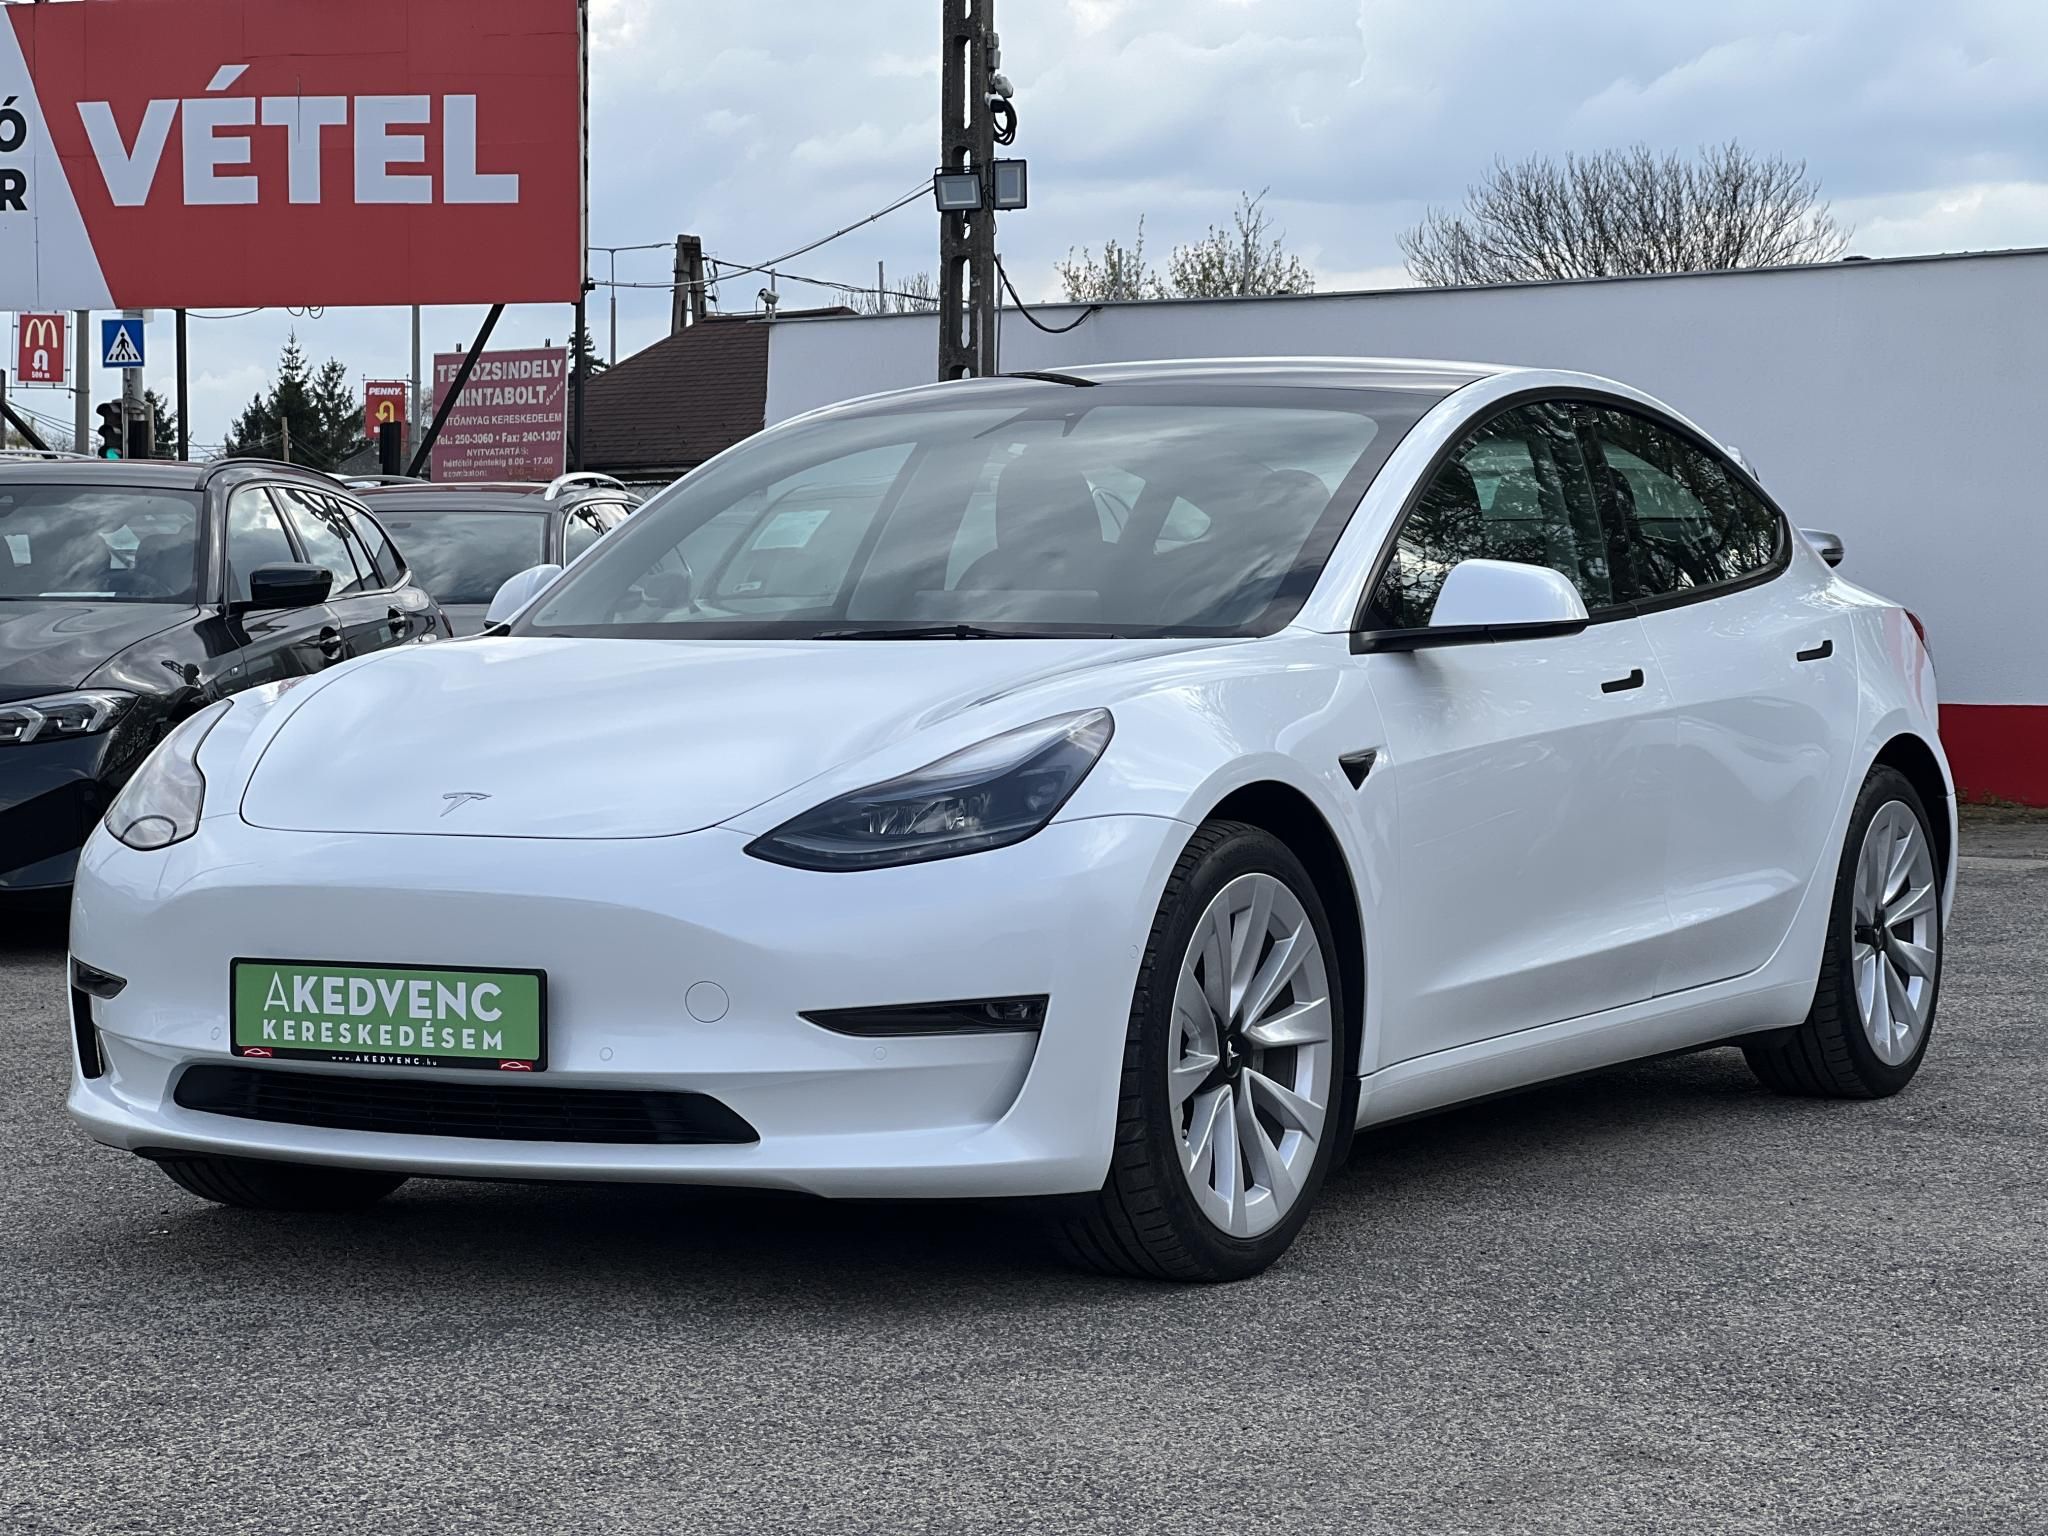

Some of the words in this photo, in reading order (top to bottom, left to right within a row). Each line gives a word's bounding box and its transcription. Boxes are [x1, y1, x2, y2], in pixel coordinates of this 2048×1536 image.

[76, 64, 520, 207] VÉTEL
[437, 358, 563, 383] TEŐZSINDELY
[492, 413, 562, 425] KERESKEDELEM
[455, 432, 494, 444] 250-3060
[502, 432, 520, 443] Fax:
[522, 431, 562, 442] 240-1307
[466, 447, 529, 457] NYITVATARTÁS:
[533, 456, 554, 465] 17.00
[262, 1018, 503, 1051] KERESKEDÉSEM
[331, 1054, 438, 1067] www.AKEDVENC.hu
